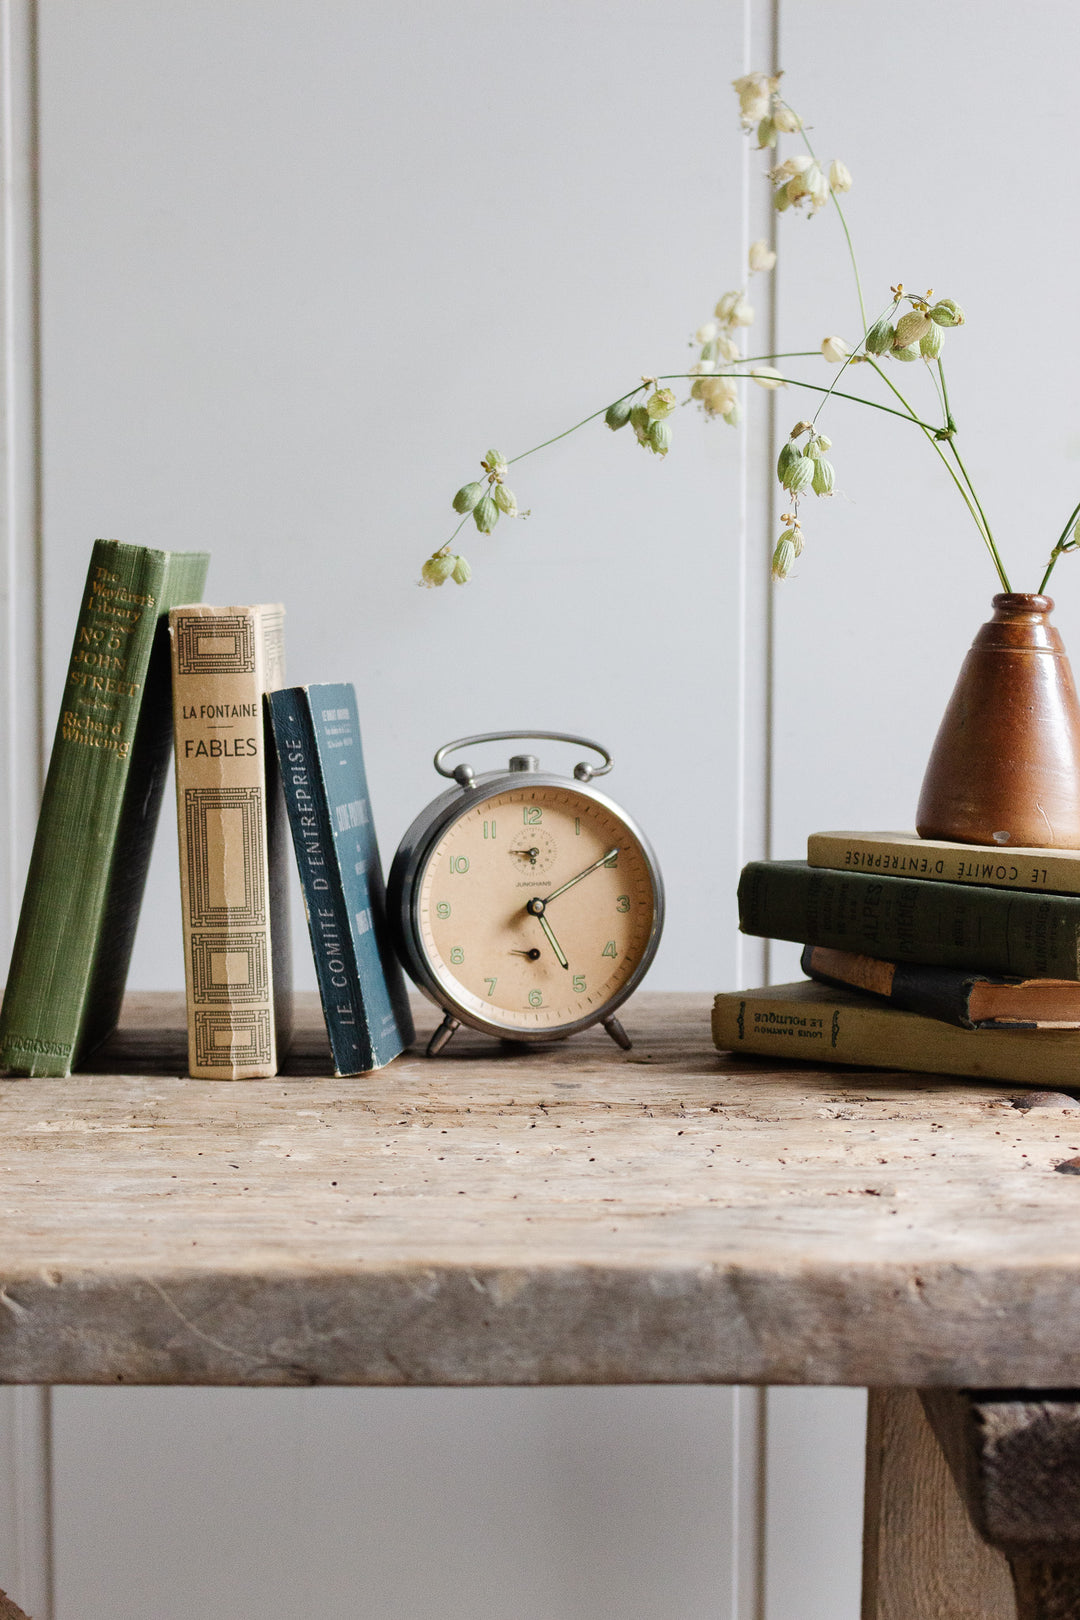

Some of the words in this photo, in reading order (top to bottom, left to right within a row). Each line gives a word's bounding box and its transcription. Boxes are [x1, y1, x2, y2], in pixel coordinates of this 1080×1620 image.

[95, 566, 120, 582] The
[93, 581, 155, 608] Wayfarer's
[88, 596, 142, 623] Library
[107, 633, 121, 650] 5
[74, 650, 127, 671] JOHN
[69, 671, 140, 698] STREET
[183, 705, 197, 719] LA
[200, 703, 258, 719] FONTAINE
[63, 711, 122, 736] Richard
[184, 738, 258, 758] FABLES
[285, 739, 330, 891] D'ENTREPRISE
[523, 807, 543, 825] 12
[483, 820, 497, 839] 11
[574, 817, 581, 836] 1
[449, 856, 470, 874] 10
[844, 851, 944, 874] D'ENTREPRISE
[957, 862, 1019, 880] COMITÉ
[1031, 868, 1048, 883] LE
[436, 902, 451, 920] 9
[616, 895, 631, 913] 3
[450, 946, 465, 965] 8
[602, 941, 618, 959] 4
[484, 977, 498, 996] 7
[572, 975, 587, 993] 5
[528, 989, 543, 1008] 6
[336, 1003, 356, 1025] LE
[754, 1012, 807, 1027] POLITIQUE
[809, 1018, 824, 1028] LE
[798, 1029, 823, 1039] LOUIS
